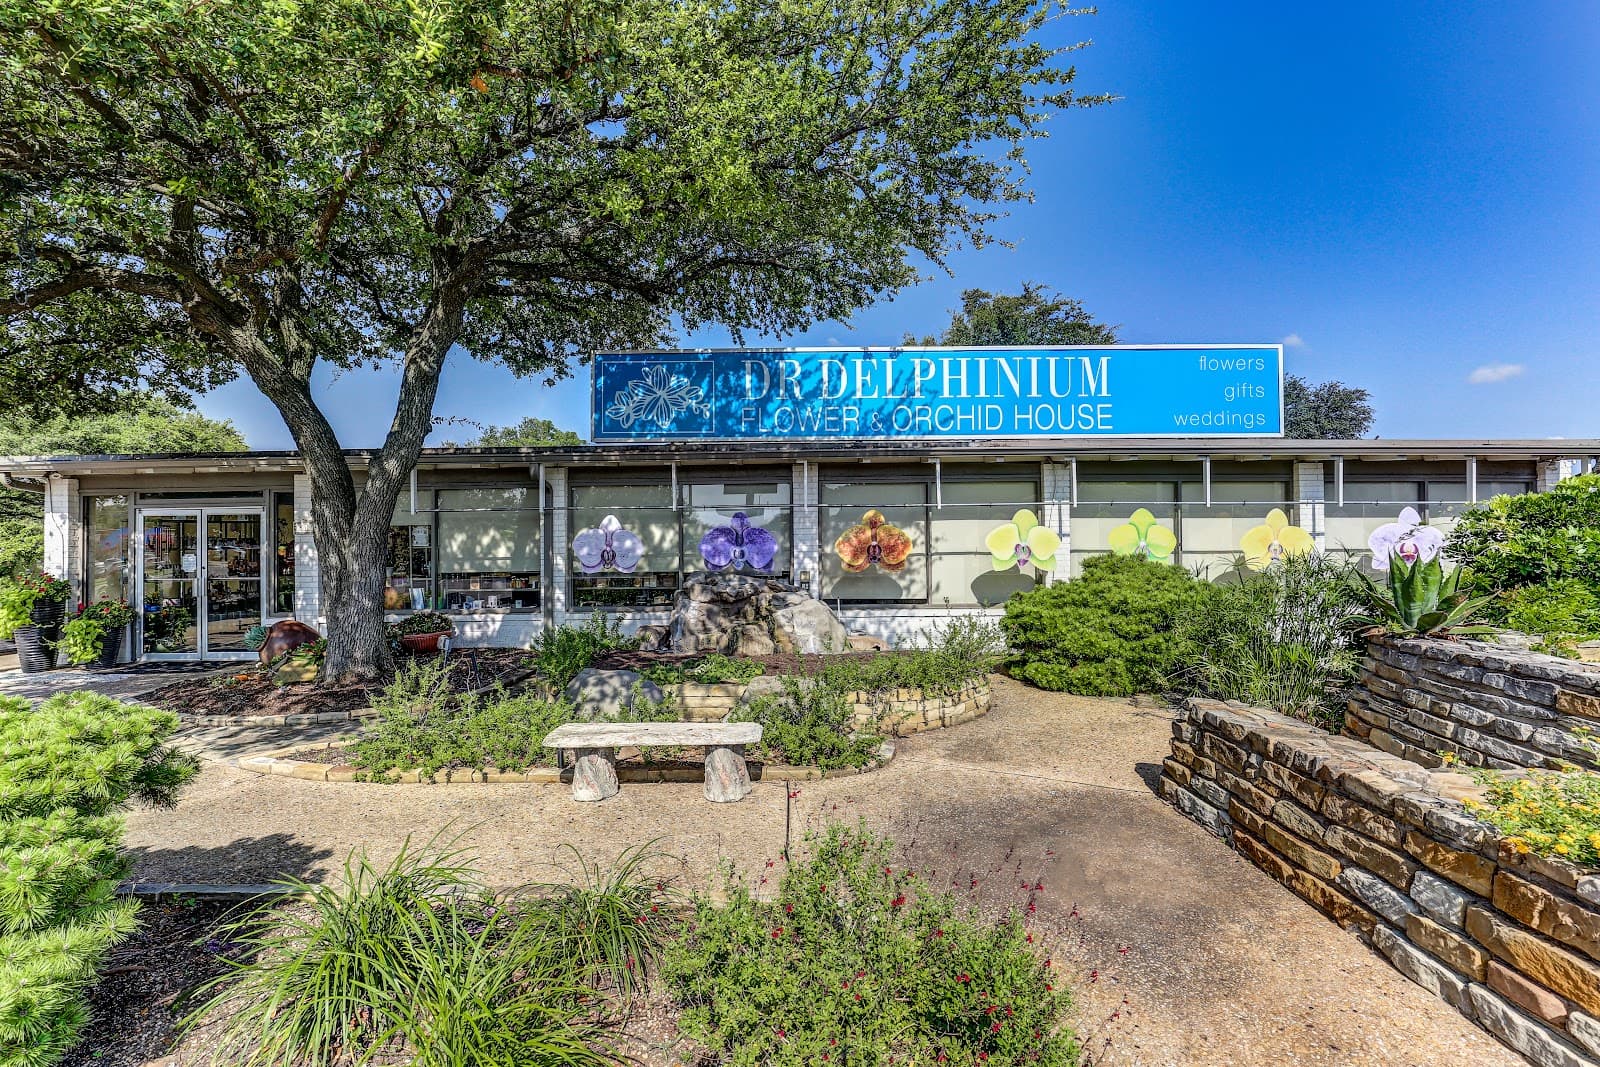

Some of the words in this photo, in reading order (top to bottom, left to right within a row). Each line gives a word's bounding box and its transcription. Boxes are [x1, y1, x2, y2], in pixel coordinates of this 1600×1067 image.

[1199, 355, 1265, 371] flowers
[741, 359, 805, 400] DR
[818, 356, 1111, 399] DELPHINIUM
[1224, 382, 1265, 402] gifts
[741, 406, 859, 432] FLOWER
[869, 412, 883, 431] &
[892, 405, 1003, 432] ORCHID
[1014, 404, 1113, 430] HOUSE
[1174, 410, 1266, 428] weddings
